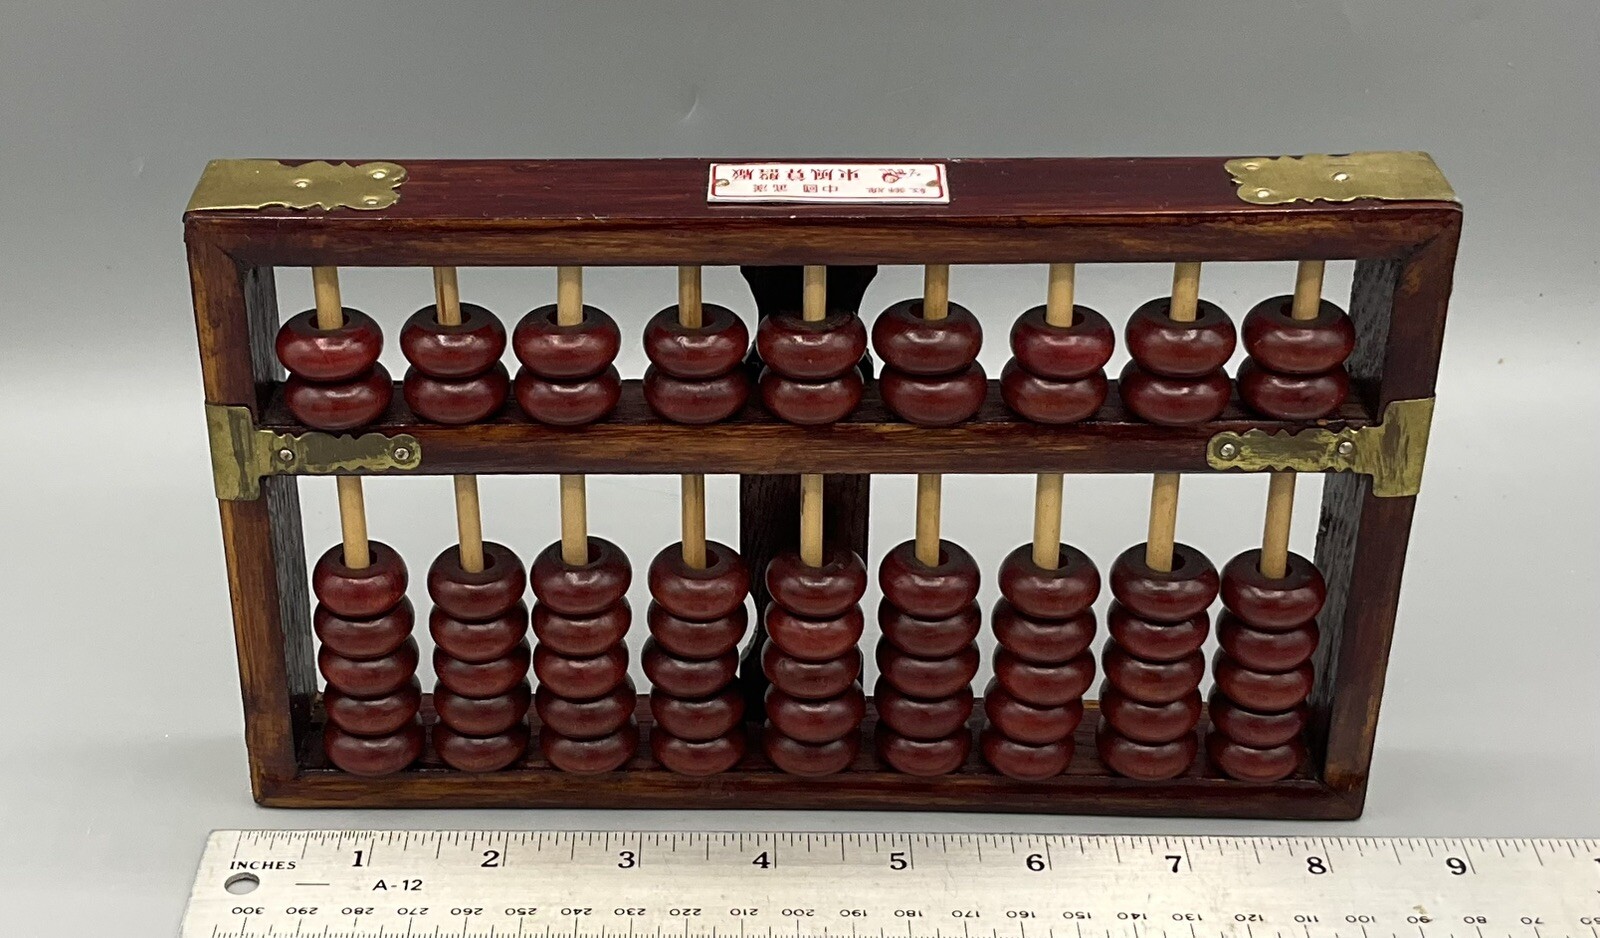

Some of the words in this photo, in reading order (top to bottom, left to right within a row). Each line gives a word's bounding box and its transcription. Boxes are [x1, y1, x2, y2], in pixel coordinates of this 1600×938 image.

[803, 184, 839, 193] 中國
[229, 860, 297, 870] INCHES
[352, 850, 363, 867] 1
[480, 850, 500, 868] 2
[617, 850, 636, 869] 3
[751, 851, 771, 869] 4
[889, 852, 908, 870] 5
[1026, 853, 1046, 872] 6
[1164, 855, 1183, 874] 7
[1306, 856, 1327, 875] 8
[1445, 857, 1468, 876] 9
[372, 879, 424, 891] A-12
[231, 907, 265, 915] 300
[285, 907, 318, 915] 290
[613, 908, 646, 916] 230
[1234, 914, 1264, 922] 120
[1294, 915, 1319, 923] 110
[1406, 915, 1431, 924] 90
[1463, 916, 1487, 924] 80
[1520, 917, 1544, 925] 70
